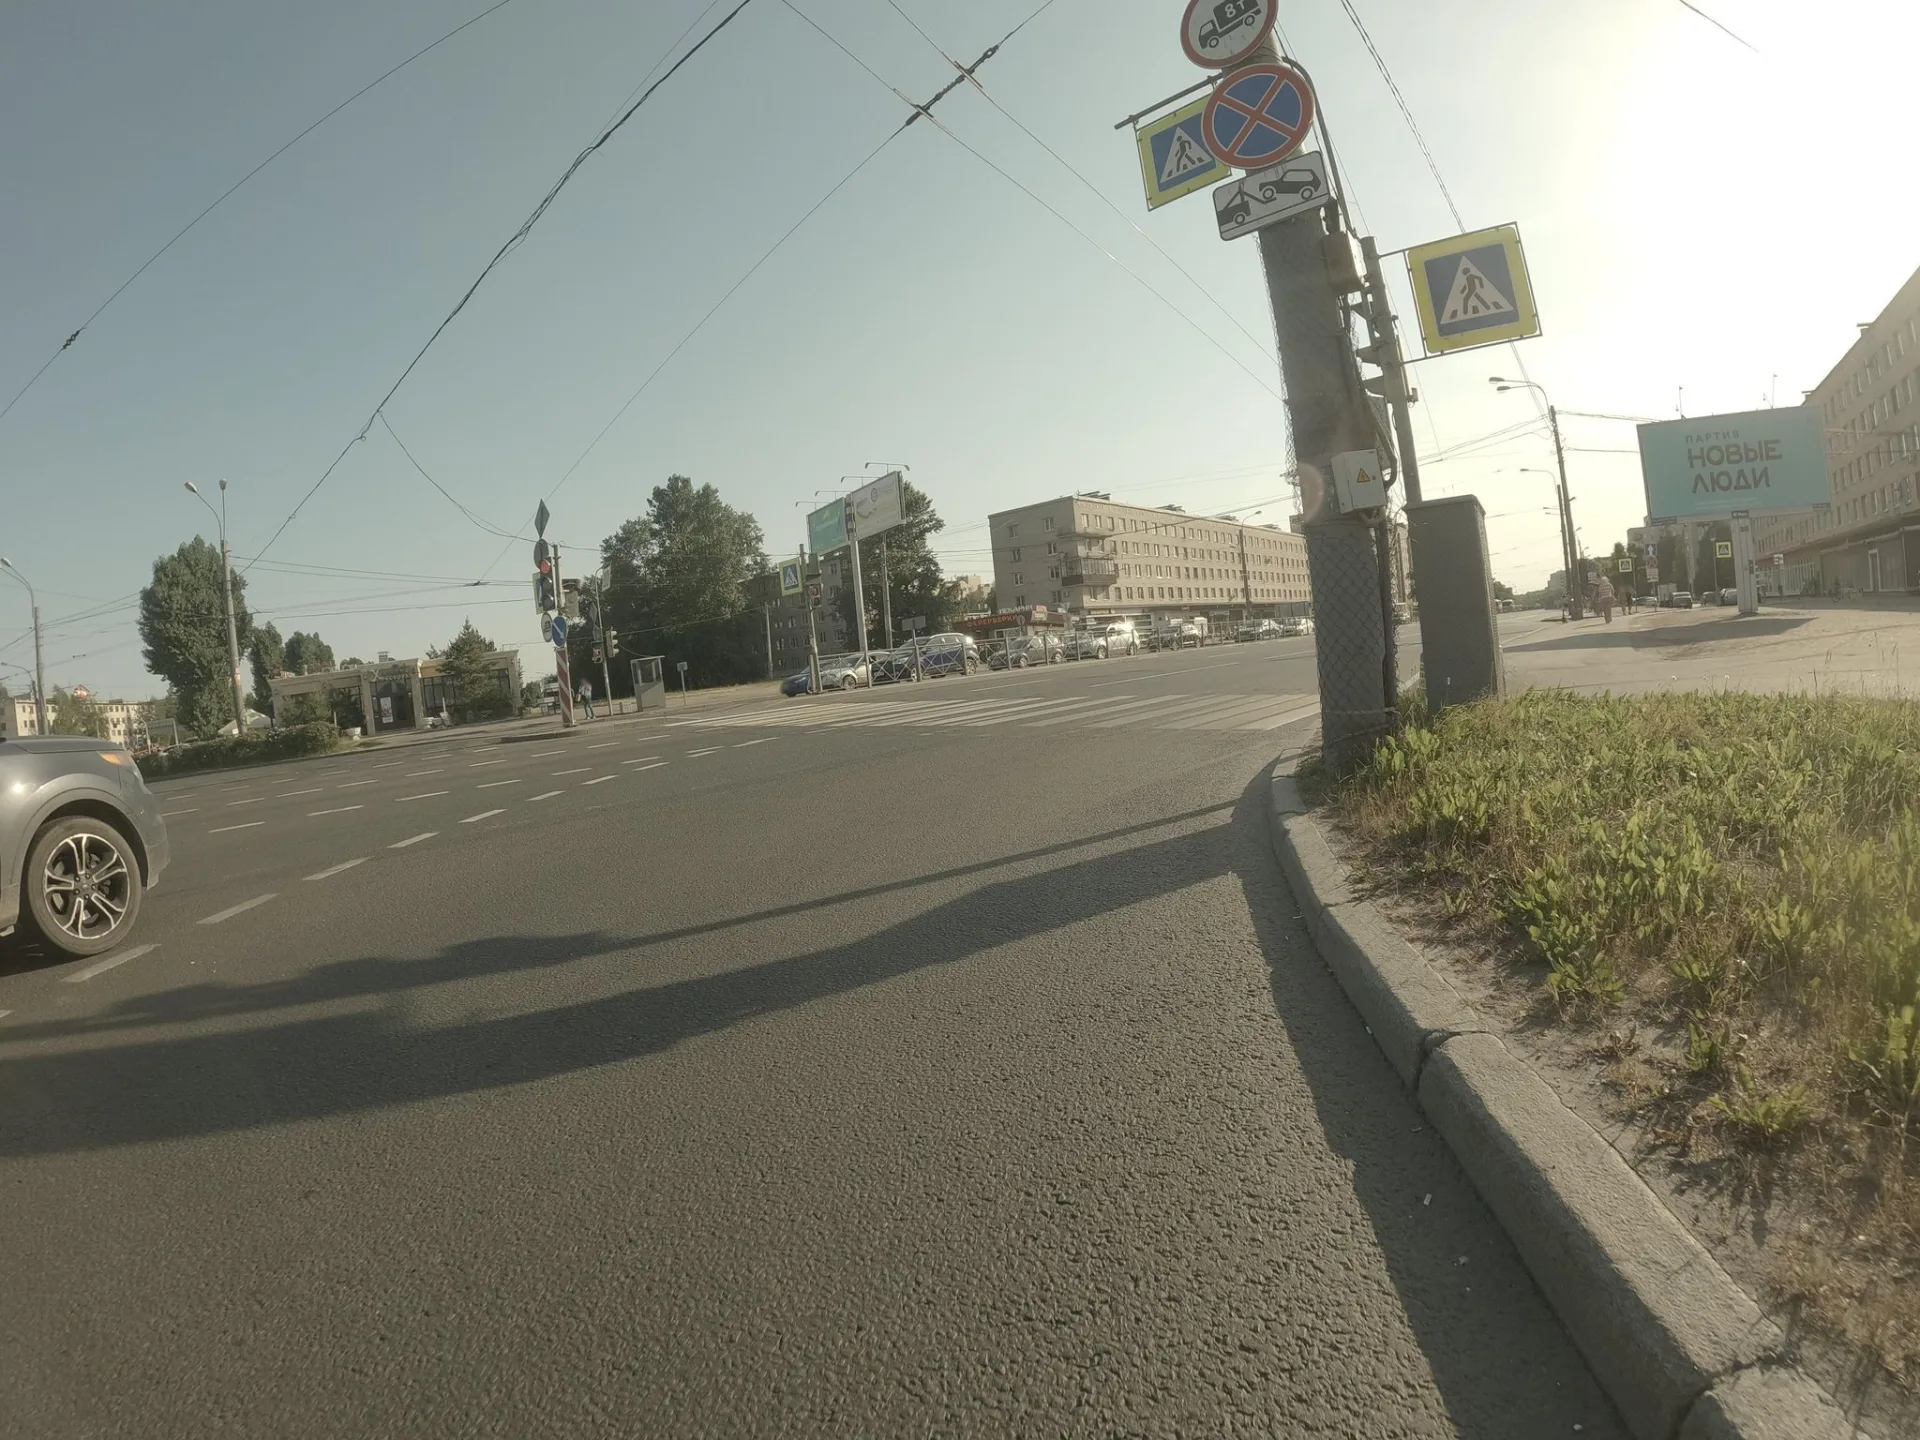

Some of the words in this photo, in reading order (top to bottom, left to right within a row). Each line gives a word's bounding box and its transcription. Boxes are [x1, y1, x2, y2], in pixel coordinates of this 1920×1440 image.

[1685, 430, 1740, 444] ПАРТИЯ
[1687, 439, 1783, 468] НОВЫЕ
[1692, 466, 1770, 493] ЛЮДИ
